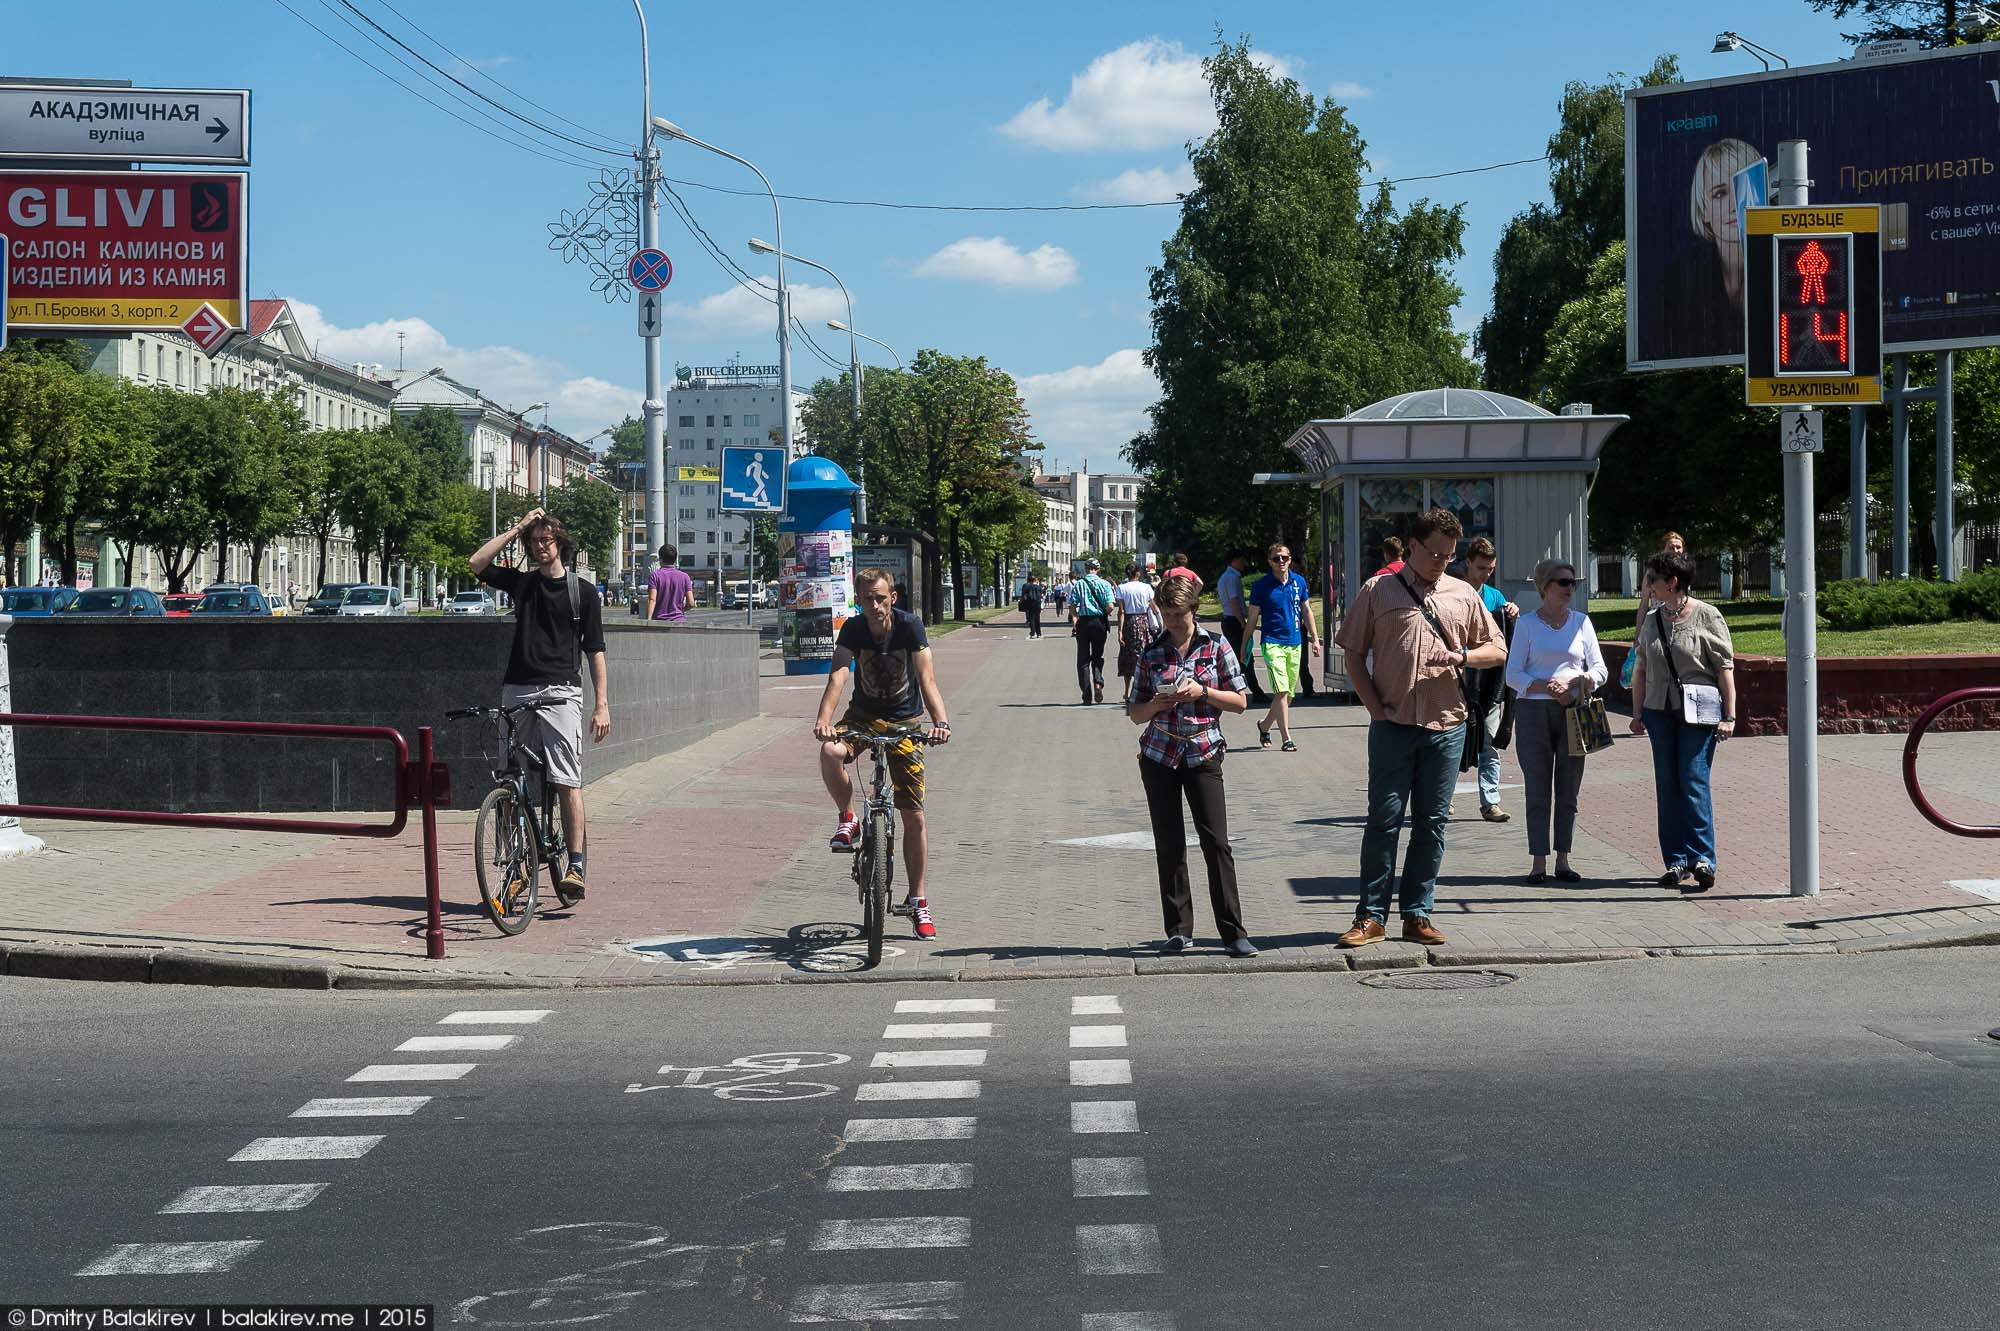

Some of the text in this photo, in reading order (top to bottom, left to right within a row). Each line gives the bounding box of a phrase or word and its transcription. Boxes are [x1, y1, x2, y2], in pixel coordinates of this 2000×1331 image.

[29, 101, 200, 122] АКАДЭМІЧНАЯ
[89, 127, 145, 144] вуліца
[1840, 157, 1995, 195] Притягивать
[8, 187, 176, 228] GLIVI
[1925, 204, 1994, 220] -6% в сети
[1781, 213, 1844, 228] БУДЗЬЦЕ
[1931, 230, 1938, 240] с
[1942, 223, 1982, 239] вашей
[12, 240, 225, 260] САЛОН КАМИНОВ И
[12, 263, 226, 288] ИЗДЕЛИЙ ИЗ КАМНЯ
[10, 305, 32, 320] ул.
[111, 304, 124, 321] 3,
[1780, 312, 1847, 365] 14
[695, 365, 779, 376] БПС-СБЕРБАНК
[1770, 382, 1860, 398] УВАЖЛІВЫМІ
[800, 636, 833, 645] LINKIN PARK
